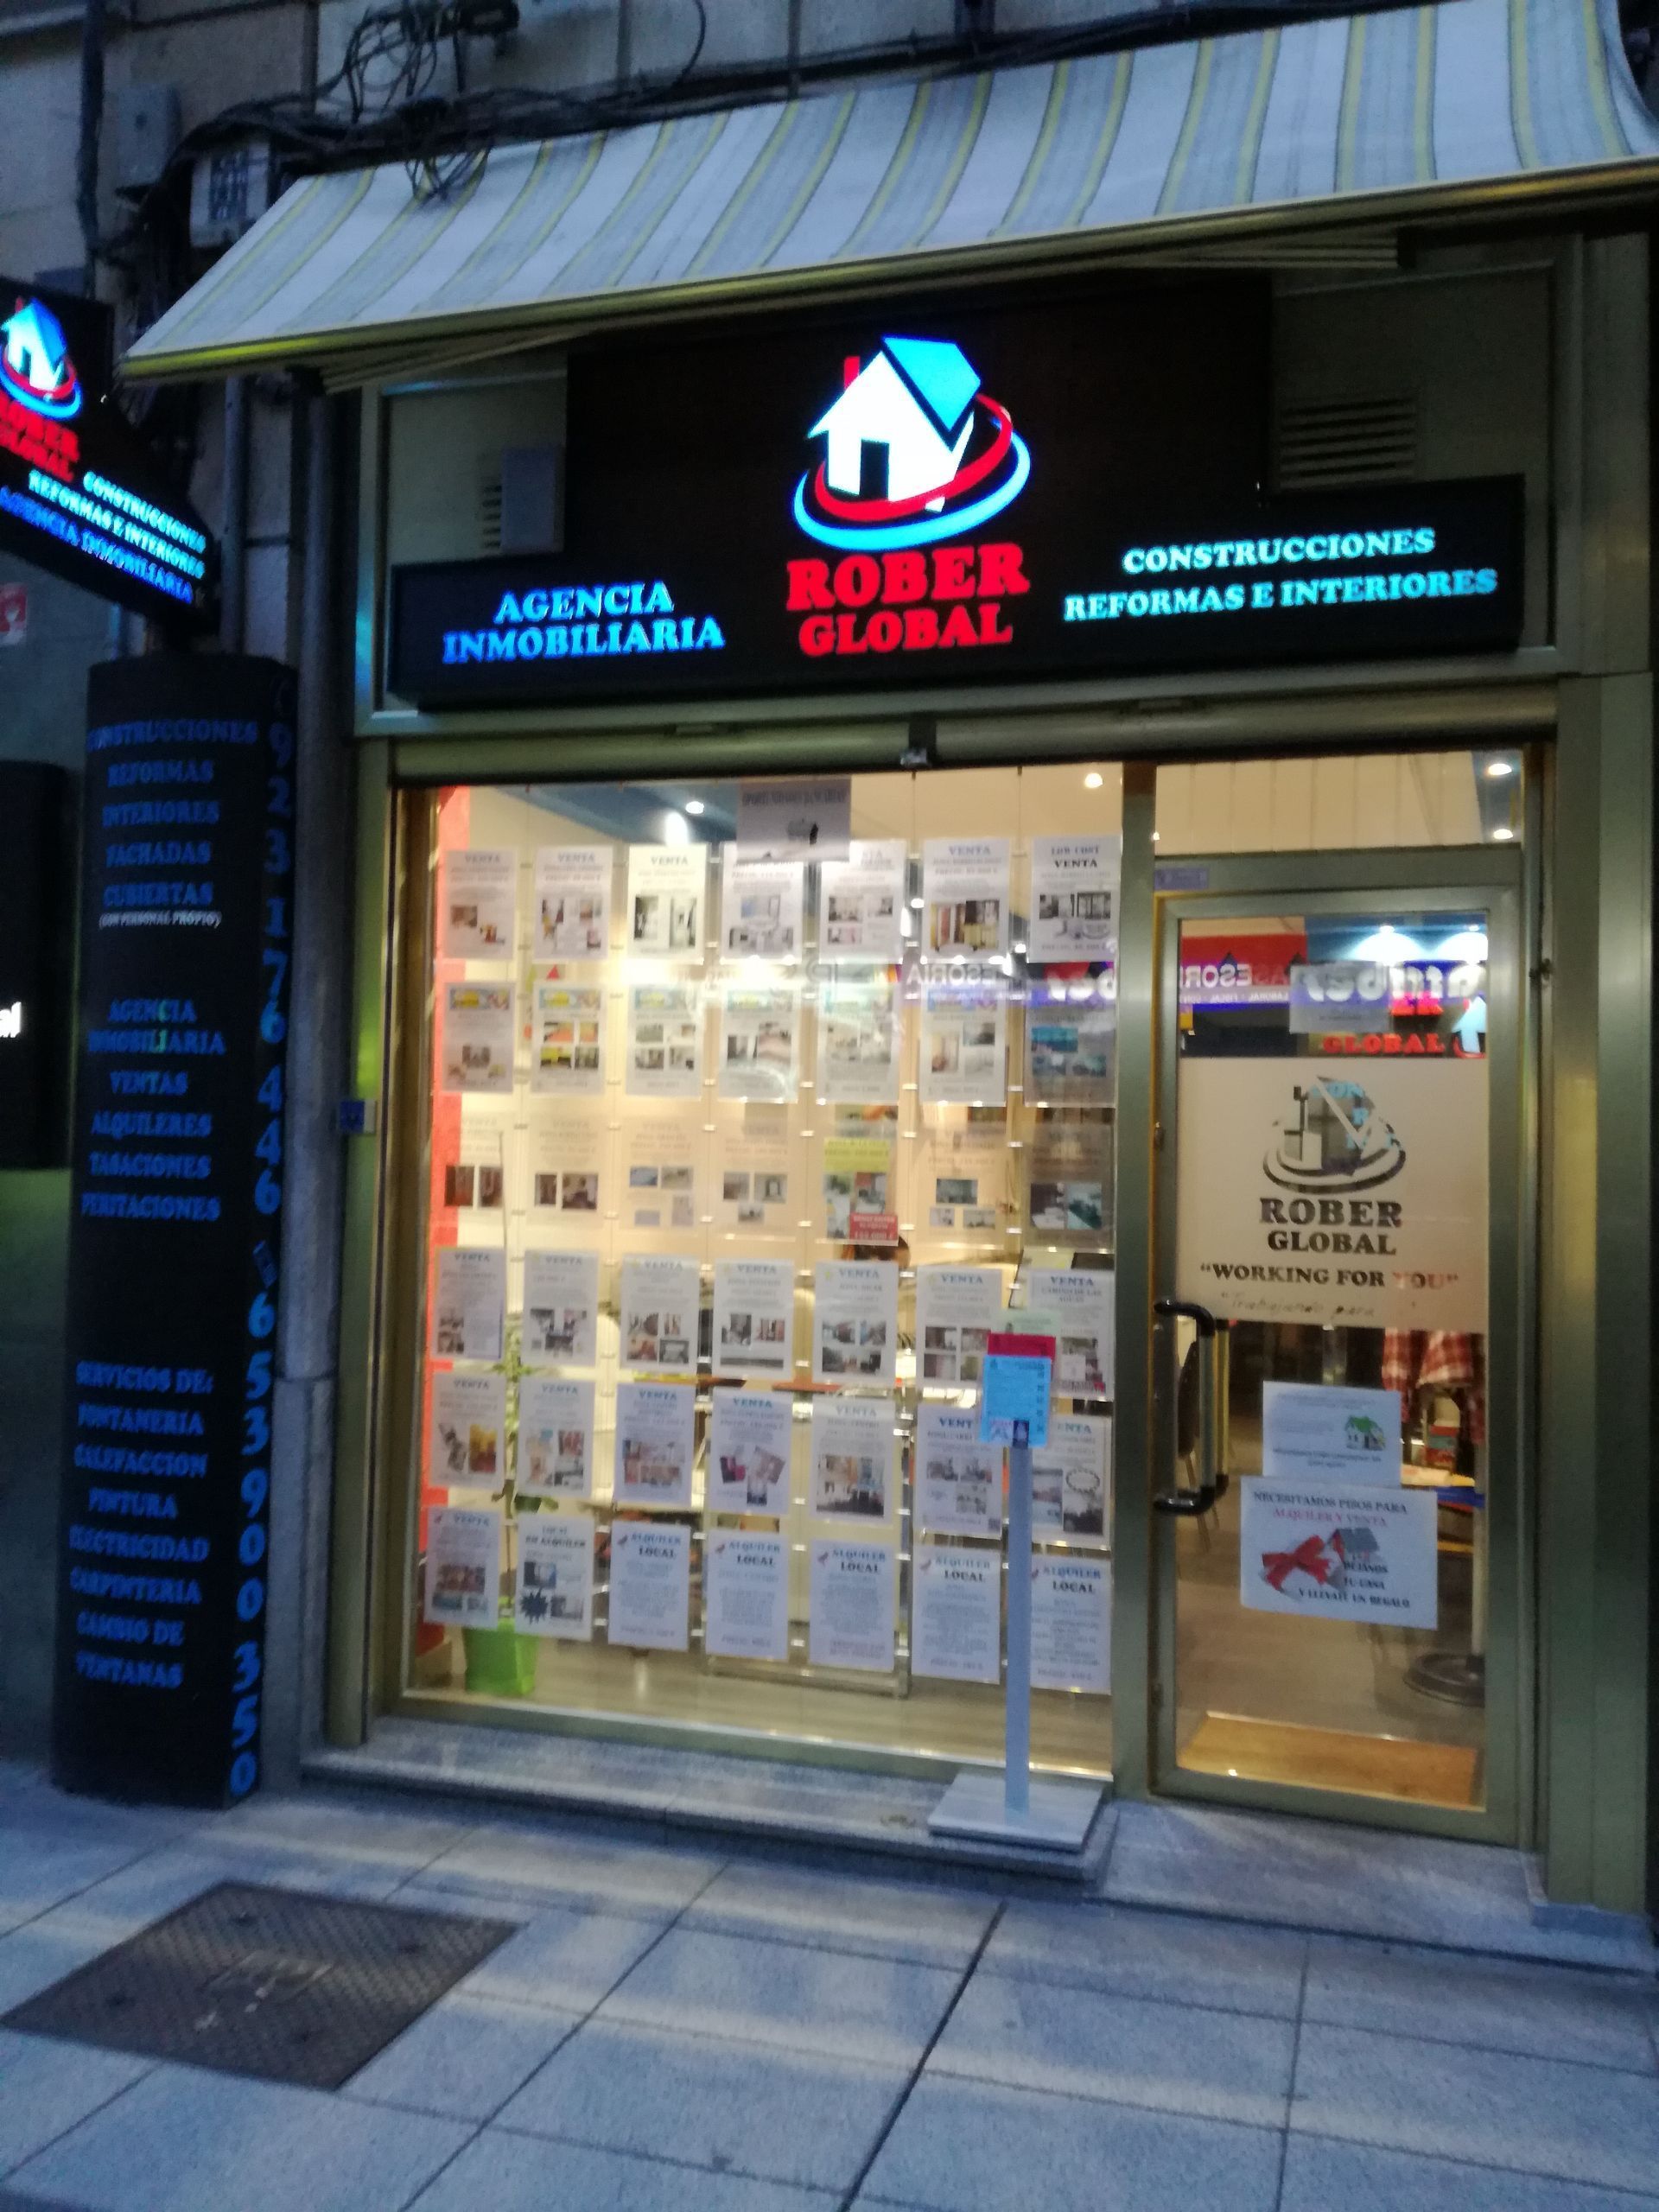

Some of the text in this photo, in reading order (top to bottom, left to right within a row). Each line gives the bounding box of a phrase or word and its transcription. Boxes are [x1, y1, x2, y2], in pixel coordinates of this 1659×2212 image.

[29, 469, 113, 531] REFORMAS
[124, 521, 206, 580] INTERIORES
[83, 471, 207, 554] CONSTRUCCIONES
[1122, 526, 1438, 576] CONSTRUCCIONES
[785, 542, 1031, 612] ROBER
[492, 579, 676, 626] AGENCIA
[1064, 569, 1499, 622] REFORMAS E INTERIORES
[442, 616, 726, 665] INMOBILIARIA
[798, 603, 1014, 658] GLOBAL
[86, 720, 257, 752] CONSTRUCCIONES
[106, 760, 213, 788] REFORMAS
[101, 800, 220, 829] INTERIORES
[105, 841, 212, 868] FACHADAS
[650, 855, 689, 866] VENTA
[948, 844, 991, 856] VENTA
[1053, 857, 1098, 868] VENTA
[103, 880, 213, 909] CUBIERTAS
[107, 998, 197, 1024] AGENCIA
[86, 1028, 226, 1055] INMOBILIARIA
[110, 1070, 188, 1096] VENTAS
[91, 1109, 213, 1140] ALQUILERES
[88, 1150, 212, 1179] TASACIONES
[1259, 1197, 1403, 1228] ROBER
[1267, 1230, 1398, 1255] GLOBAL
[736, 1263, 777, 1275] VENTA
[838, 1268, 880, 1279] VENTA
[940, 1273, 983, 1284] VENTA
[1050, 1275, 1094, 1287] VENTA
[1337, 1268, 1385, 1287] FOR
[75, 1360, 172, 1393] SERVICIOS
[733, 1397, 773, 1409] VENTA
[88, 1486, 177, 1520] PINTURA
[1253, 1491, 1408, 1514] NECESITAMOS PISOS PARA
[639, 1547, 677, 1558] LOCAL
[736, 1554, 777, 1567] LOCAL
[840, 1560, 880, 1573] LOCAL
[944, 1569, 986, 1583] LOCAL
[1052, 1580, 1096, 1594] LOCAL
[152, 1618, 183, 1646] DE
[75, 1649, 183, 1688] VENTANAS
